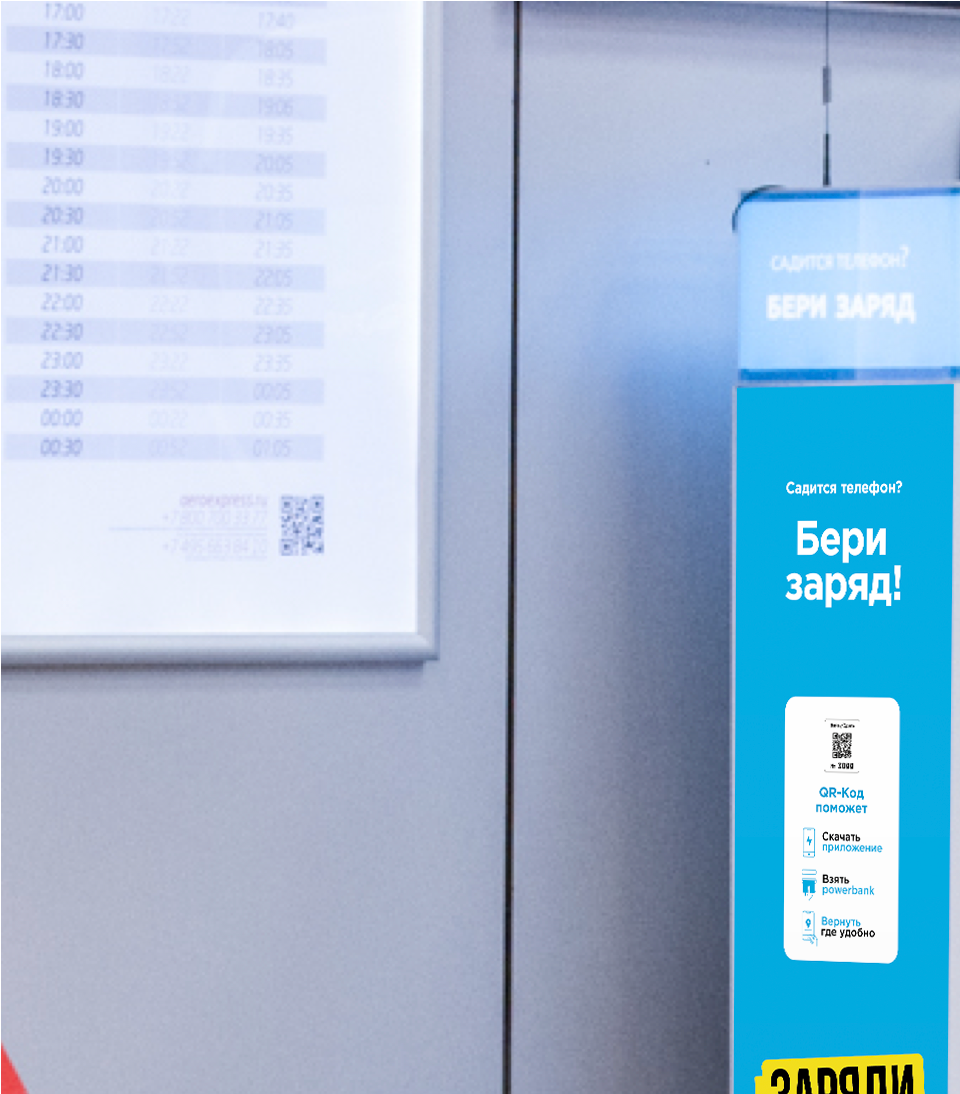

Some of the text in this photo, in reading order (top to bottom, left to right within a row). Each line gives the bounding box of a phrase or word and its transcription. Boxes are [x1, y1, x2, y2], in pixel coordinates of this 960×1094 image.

[45, 3, 84, 22] 17:00
[45, 32, 84, 51] 17:30
[45, 61, 84, 80] 18:00
[45, 90, 84, 109] 18:30
[45, 119, 84, 138] 19:00
[45, 148, 84, 167] 19:30
[41, 177, 84, 196] 20:00
[41, 206, 83, 225] 20:30
[41, 235, 83, 254] 21:00
[771, 245, 910, 272] САДИТСЯ ТЕЛЕФОН?
[41, 264, 83, 283] 21:30
[41, 293, 83, 312] 22:00
[767, 292, 917, 324] БЕРИ ЗАРЯД
[41, 322, 83, 341] 22:30
[41, 351, 83, 370] 23:00
[41, 380, 83, 399] 23:30
[41, 409, 83, 428] 00:00
[40, 438, 83, 457] 00:30
[786, 480, 902, 496] Садится телефон?
[797, 520, 886, 563] Бери
[785, 565, 901, 608] заряд!
[819, 786, 864, 800] QR-Код
[816, 804, 867, 813] поможет
[822, 831, 860, 842] Скачать
[822, 844, 883, 853] приложение
[822, 874, 850, 884] Взять
[822, 885, 875, 895] powerbank
[821, 916, 861, 928] Вернуть
[821, 927, 875, 938] где удобно
